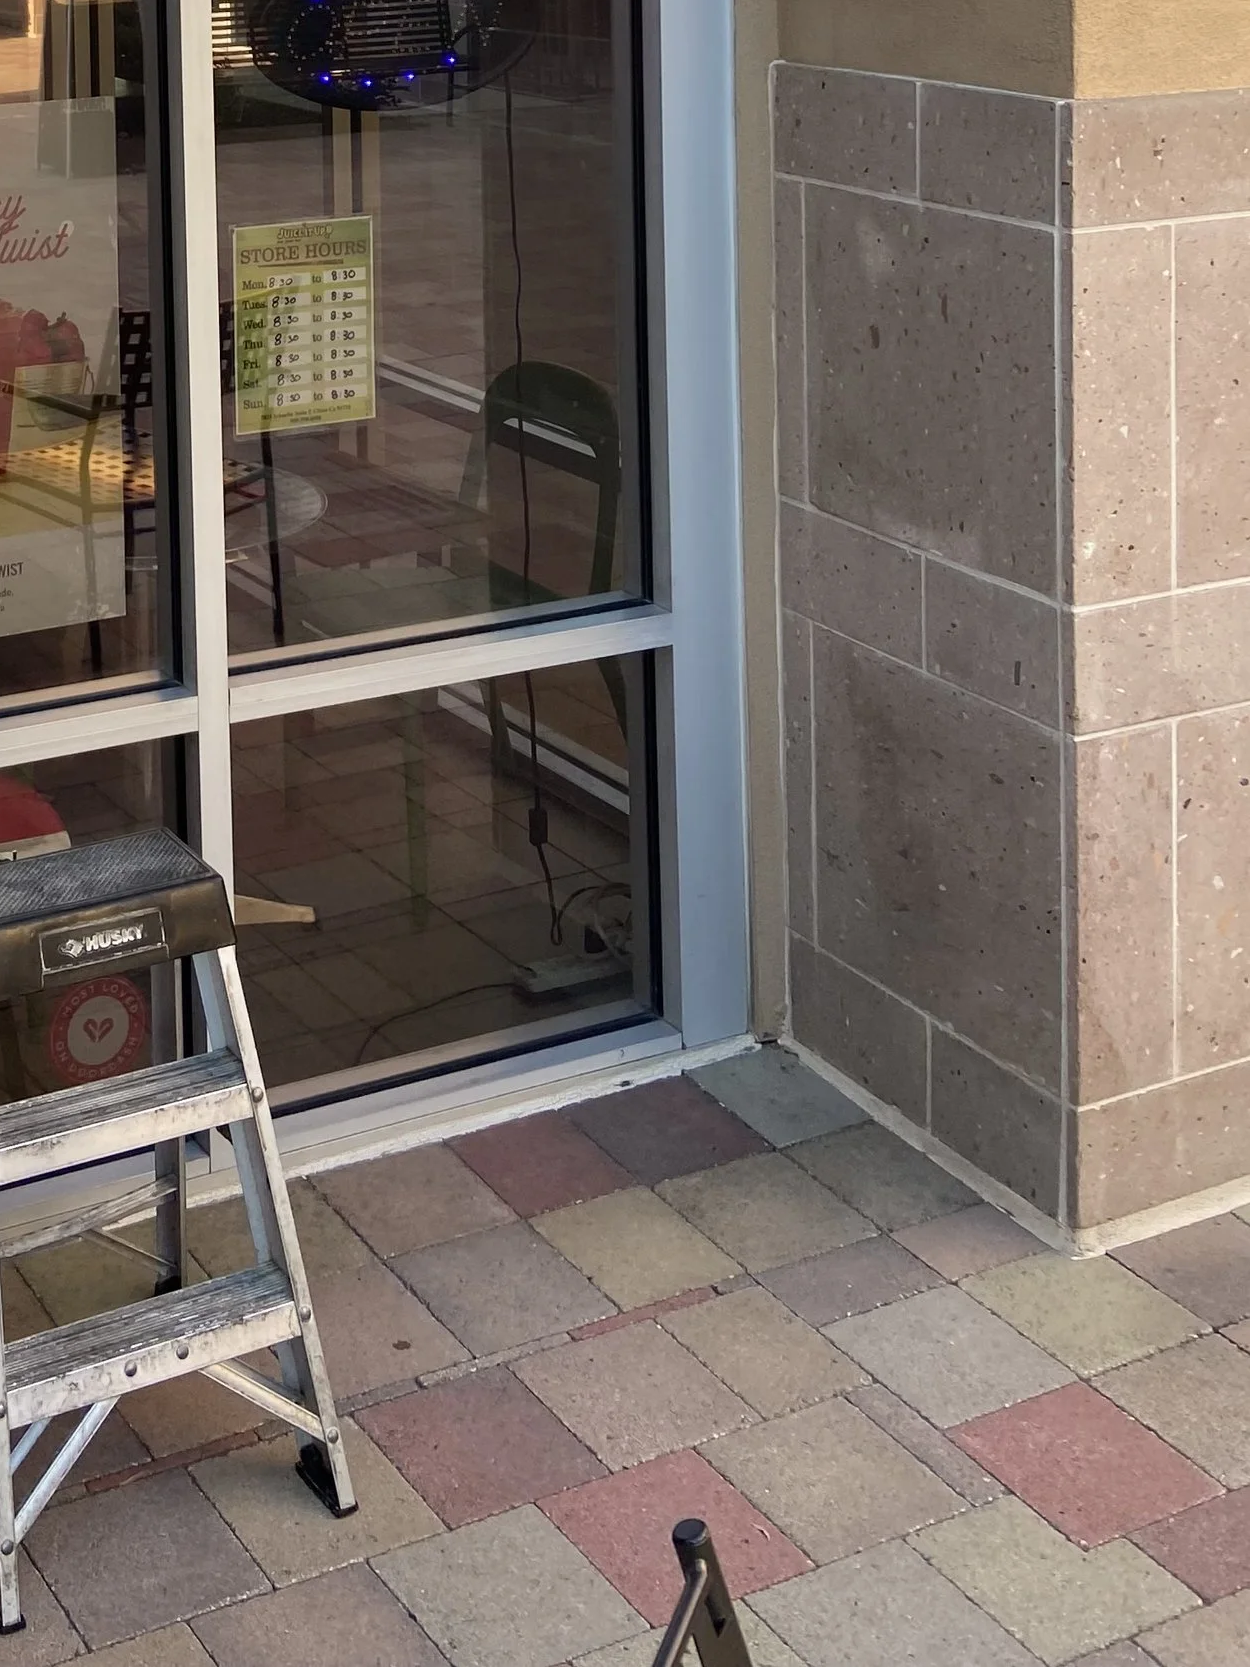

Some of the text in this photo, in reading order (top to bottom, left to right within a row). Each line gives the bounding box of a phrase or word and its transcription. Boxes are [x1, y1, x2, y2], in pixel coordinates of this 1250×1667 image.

[240, 239, 367, 265] STORE HOURS
[242, 280, 267, 290] Mon.
[312, 275, 322, 283] to
[312, 294, 322, 303] to
[312, 314, 322, 323] to
[312, 334, 322, 342] to
[312, 353, 323, 362] to
[313, 373, 323, 381] to
[313, 392, 323, 401] to
[84, 923, 145, 952] HUSKY
[62, 984, 138, 1017] MOST LOVED
[55, 1041, 68, 1062] ON
